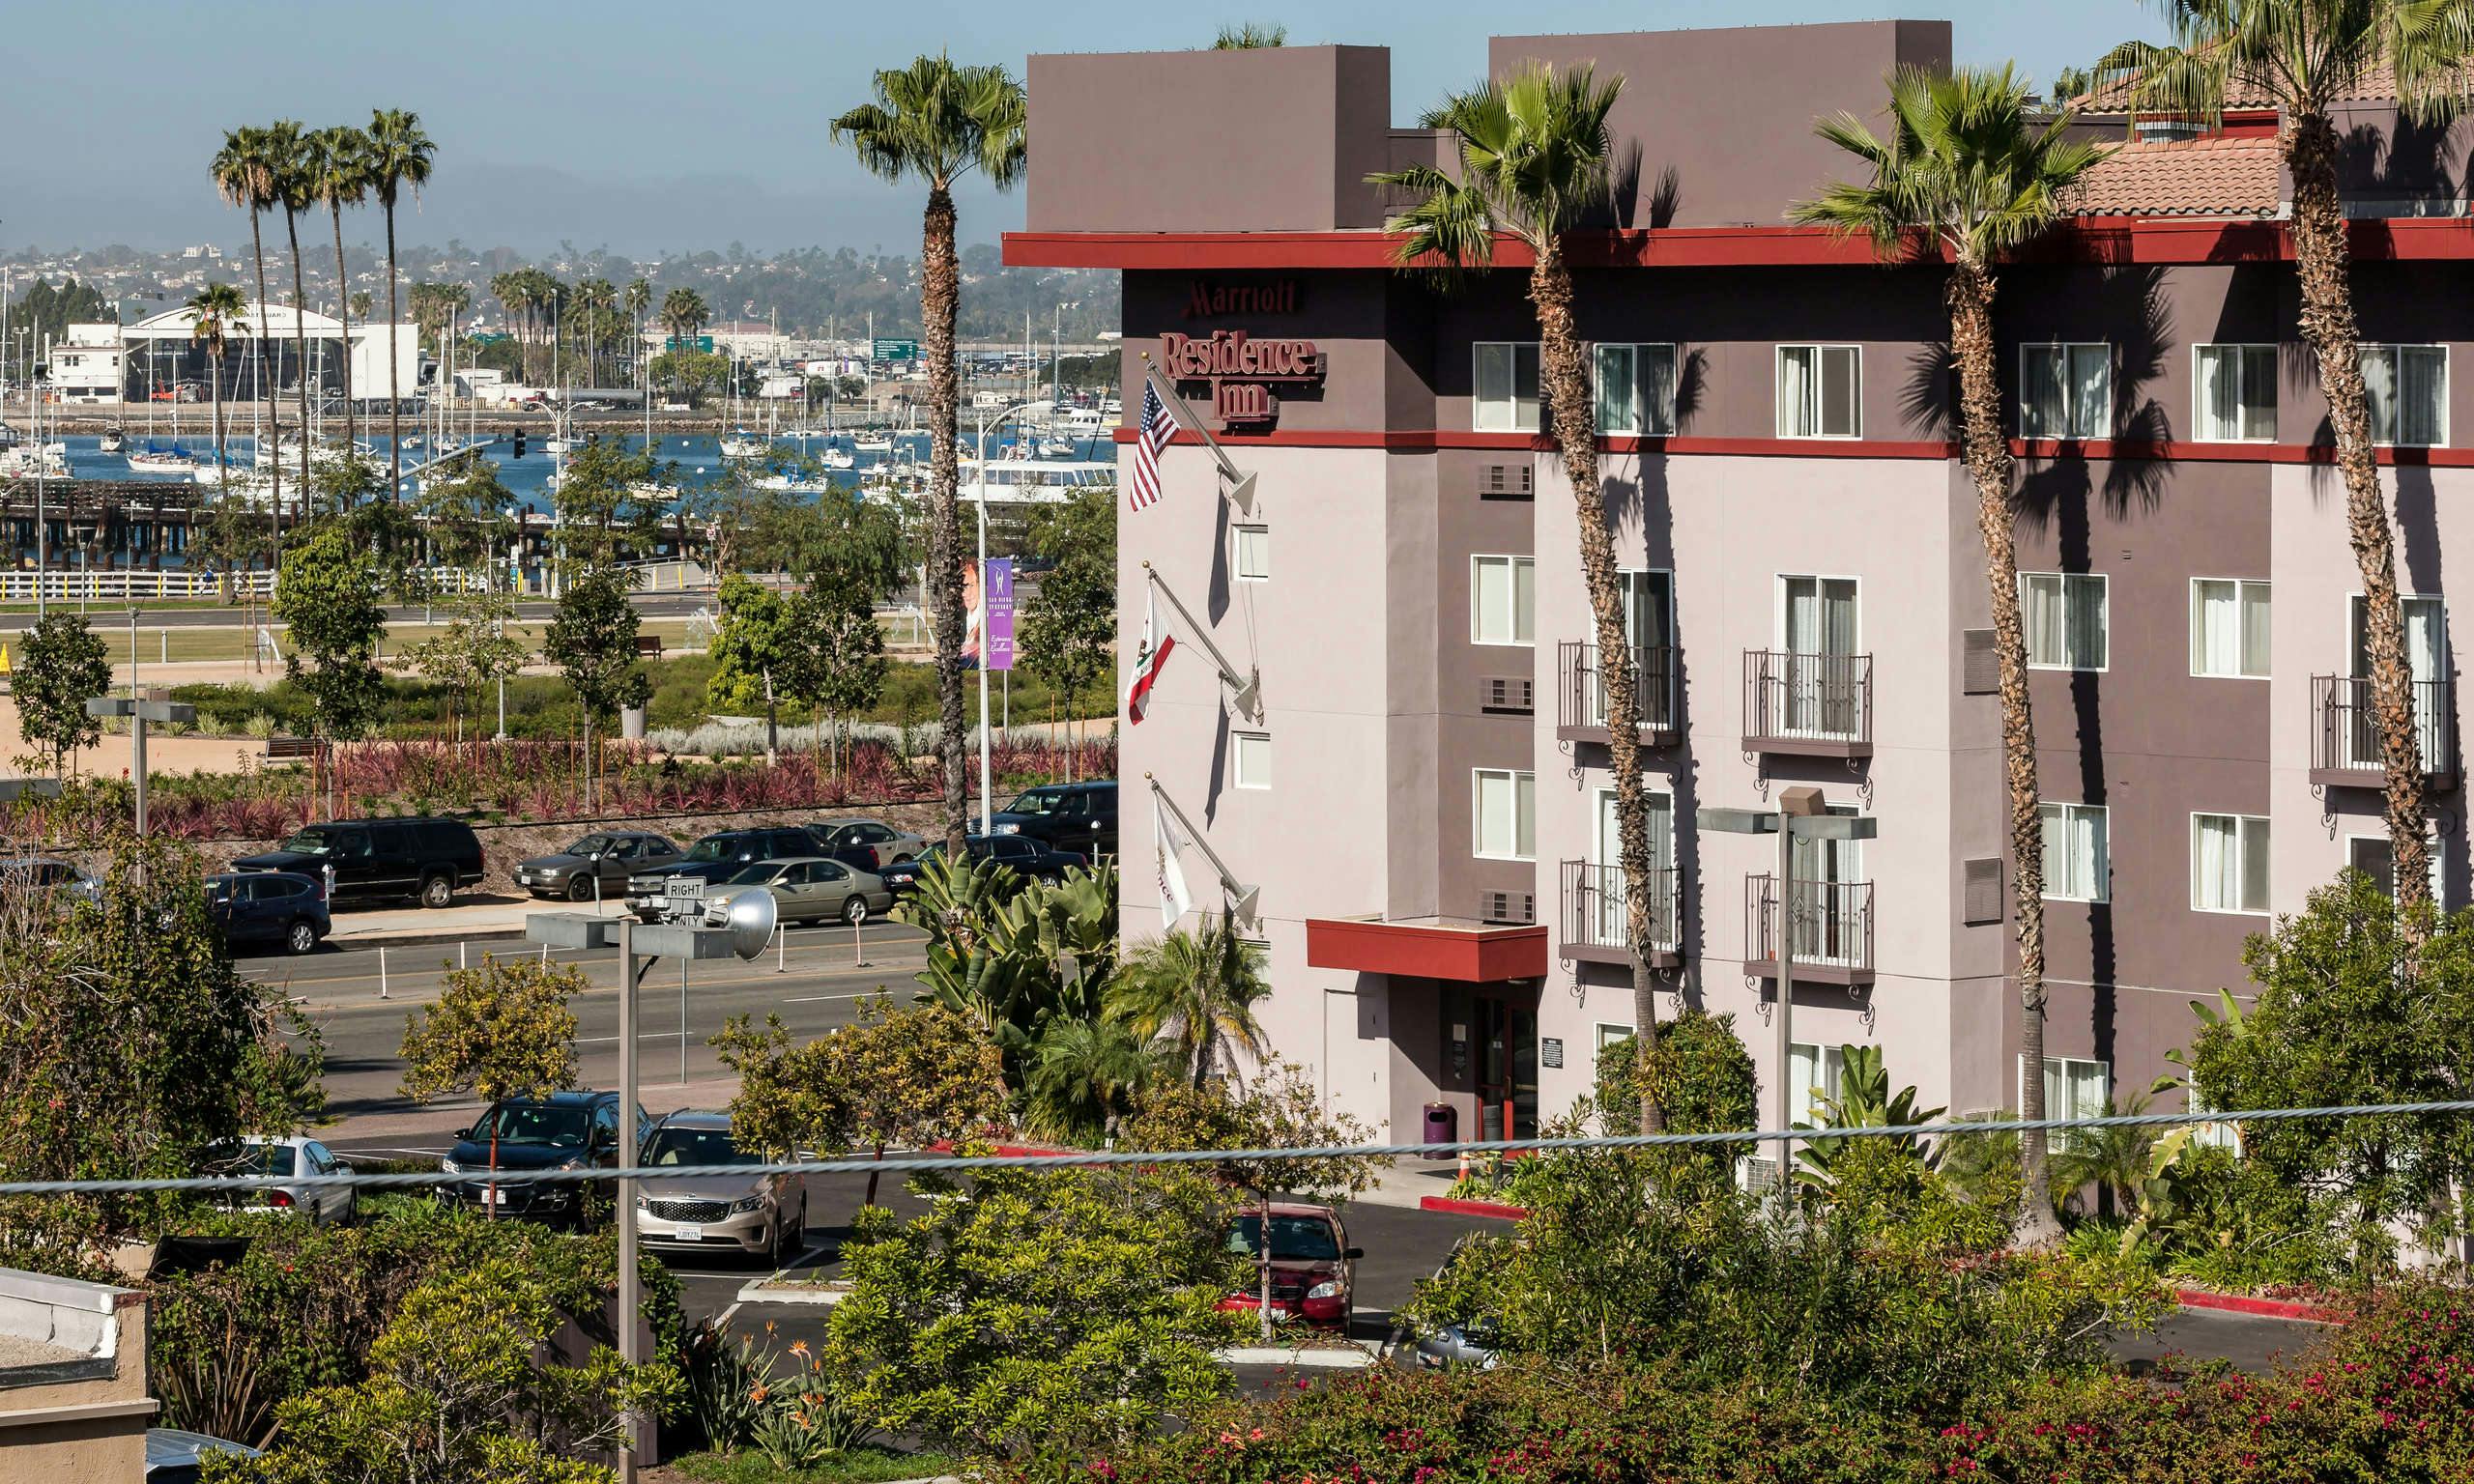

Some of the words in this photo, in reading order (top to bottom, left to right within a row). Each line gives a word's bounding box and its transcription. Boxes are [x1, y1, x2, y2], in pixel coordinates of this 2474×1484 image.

[1178, 276, 1296, 318] Marriott
[1160, 329, 1318, 380] Residence
[1209, 375, 1272, 421] Inn
[671, 884, 702, 896] RIGHT
